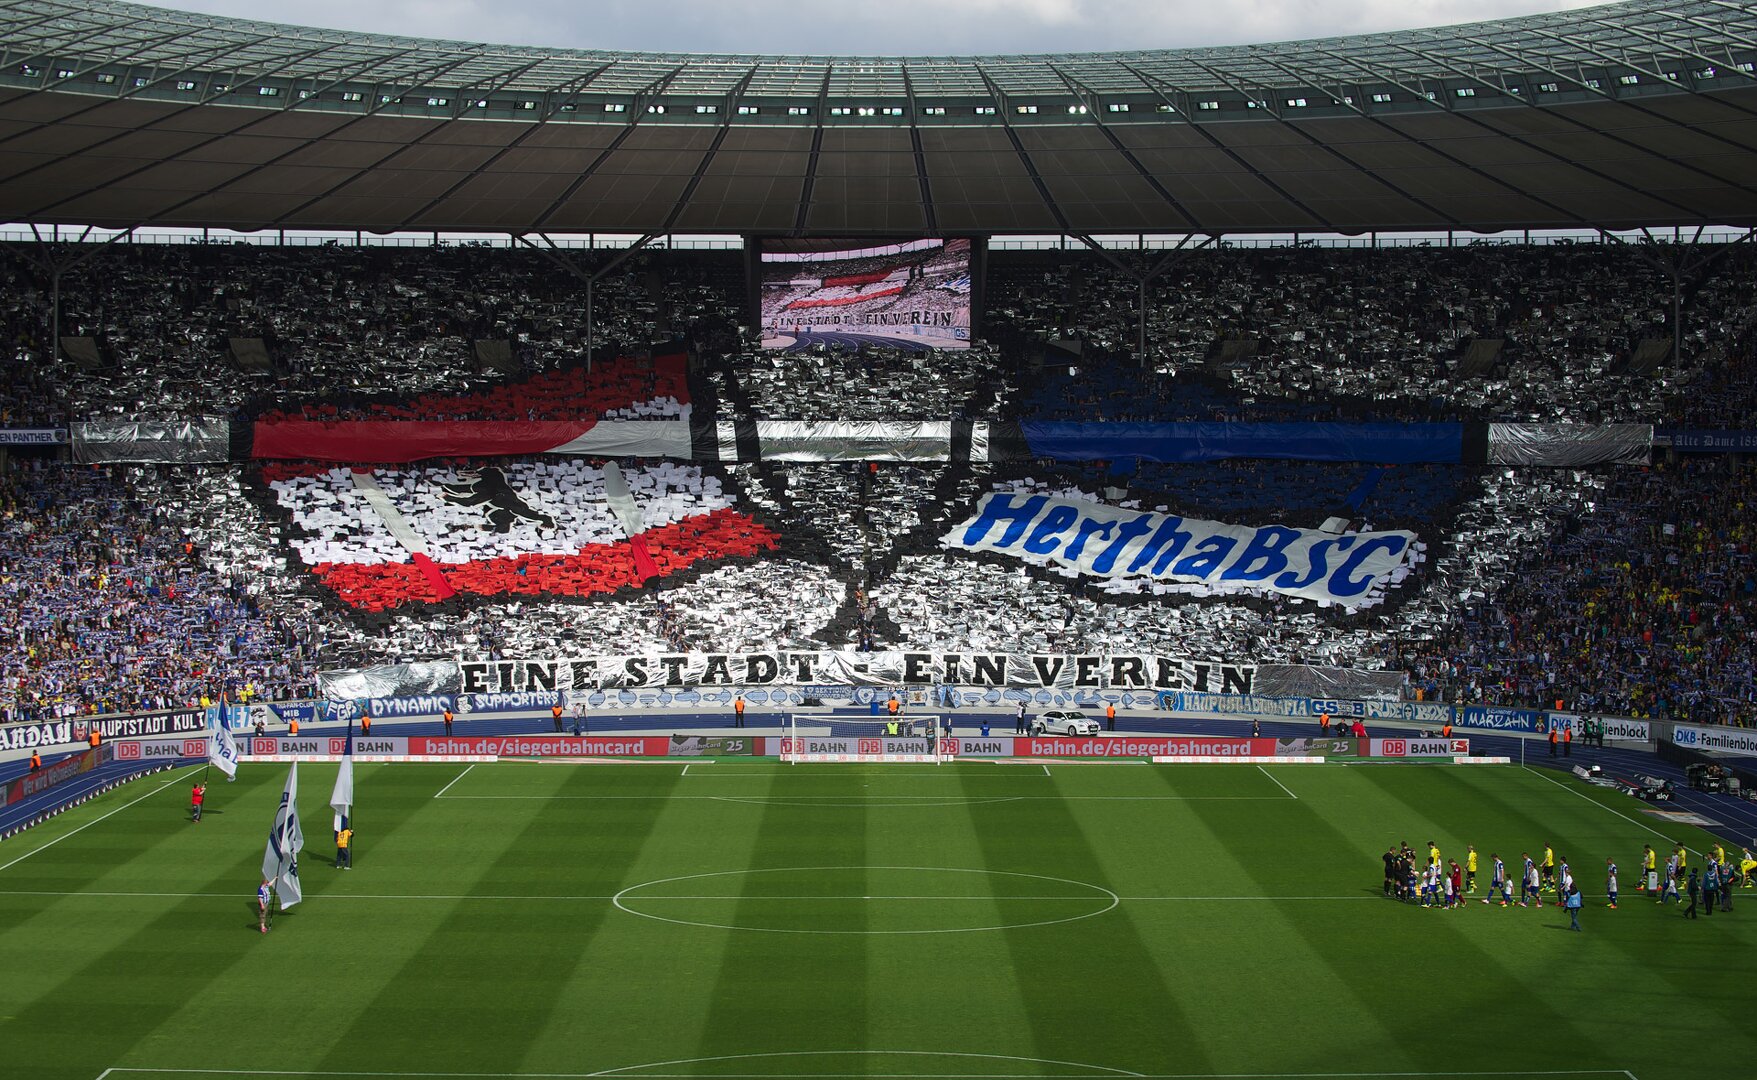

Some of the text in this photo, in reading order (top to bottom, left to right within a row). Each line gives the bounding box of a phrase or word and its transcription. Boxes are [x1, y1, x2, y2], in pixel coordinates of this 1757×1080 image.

[807, 315, 850, 325] STADT
[866, 313, 889, 324] EIN
[893, 311, 952, 327] VEREIN
[13, 432, 53, 442] PANTHER
[1704, 435, 1735, 447] Dame
[461, 662, 598, 693] EINE
[625, 654, 820, 687] STADT
[903, 653, 1007, 686] EIN
[1033, 656, 1255, 694] VEREIN
[372, 696, 450, 717] DYNAMIC
[475, 691, 559, 709] SUPPORTERS
[1312, 701, 1338, 714] GS
[1367, 701, 1401, 719] RUDE
[1415, 703, 1450, 722] BOYS
[92, 715, 167, 738] HAUPTSTADT
[1468, 711, 1530, 729] MARZAHN
[119, 743, 139, 758] DB
[145, 744, 179, 756] BAHN
[185, 741, 205, 755] DB
[256, 739, 276, 754] DB
[282, 742, 318, 753] BAHN
[357, 742, 394, 753] BAHN
[425, 739, 644, 756] bahn.de/siegerbahncard
[726, 740, 743, 752] 25
[810, 742, 847, 753] BAHN
[859, 739, 924, 753] DB BAHN
[964, 742, 1002, 753] BAHN
[1031, 739, 1251, 756] bahn.de/siegerbahncard
[1332, 740, 1349, 753] 25
[1384, 741, 1448, 754] DB BAHN
[1656, 792, 1670, 801] sky
